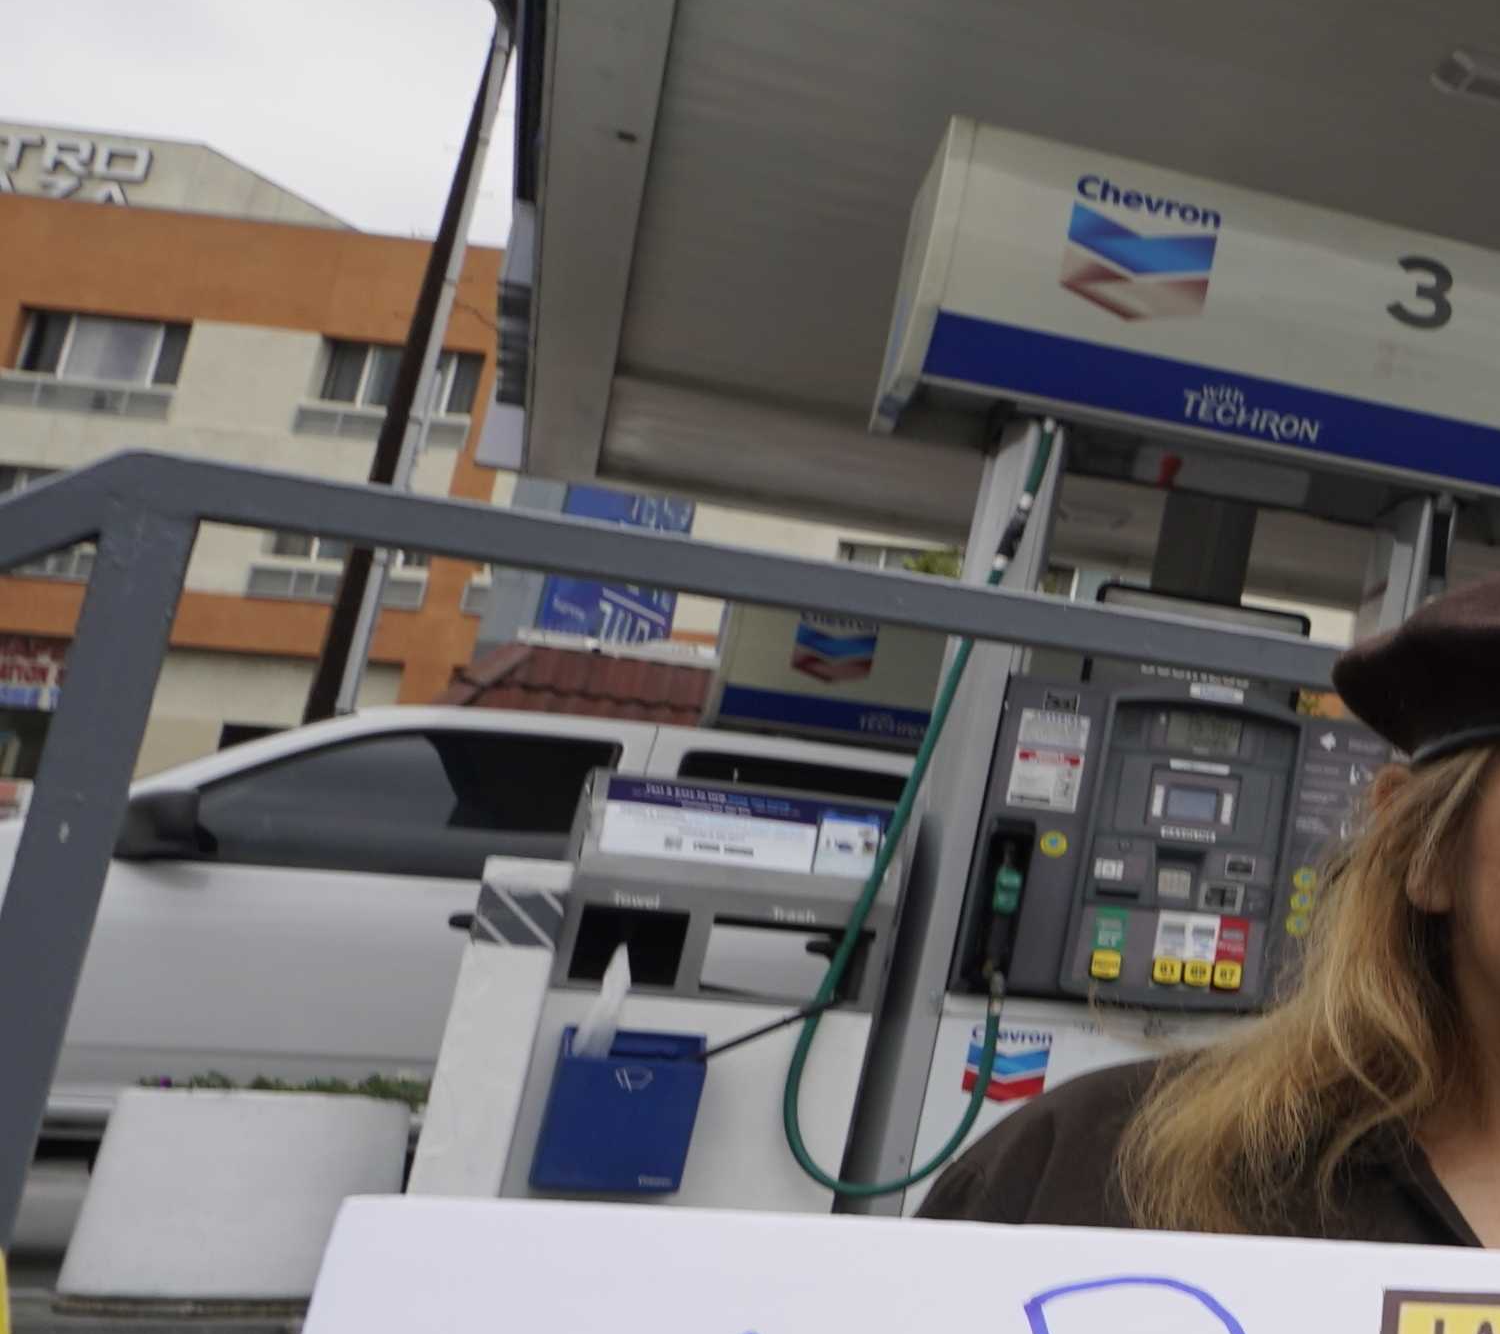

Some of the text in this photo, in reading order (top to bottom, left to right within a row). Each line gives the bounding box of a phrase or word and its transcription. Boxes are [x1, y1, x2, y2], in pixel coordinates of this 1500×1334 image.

[1077, 174, 1222, 230] Chevron
[1386, 255, 1454, 329] 3
[1183, 388, 1322, 444] TECHRON
[1203, 384, 1245, 407] with
